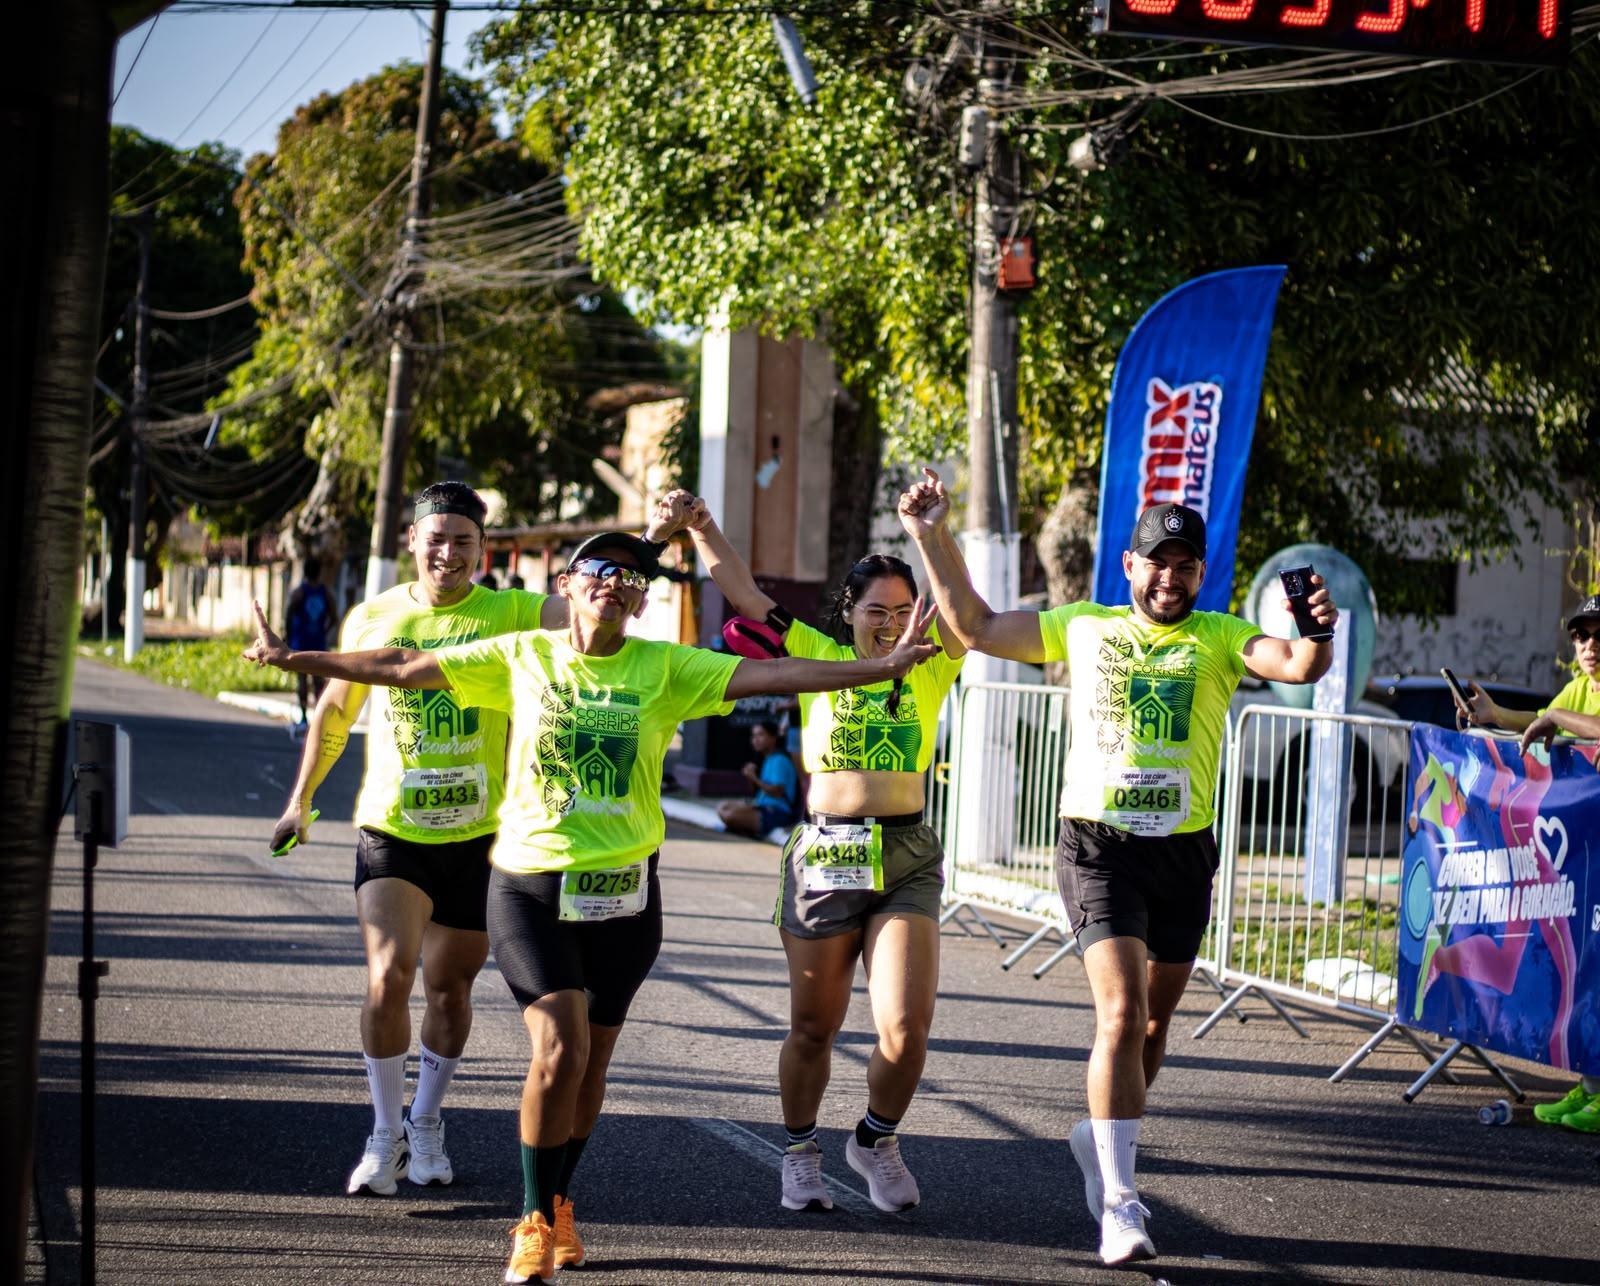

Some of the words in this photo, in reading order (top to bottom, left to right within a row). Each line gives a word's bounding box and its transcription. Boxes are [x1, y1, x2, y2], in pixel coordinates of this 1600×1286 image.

[576, 708, 640, 723] CORRIDA
[576, 717, 640, 731] CORRIDA
[416, 787, 468, 807] 0343
[1114, 788, 1170, 808] 0346
[816, 845, 867, 863] 0348
[578, 872, 632, 893] 0275
[1448, 889, 1480, 925] BEM
[1479, 886, 1511, 924] PARA
[1510, 885, 1521, 921] O
